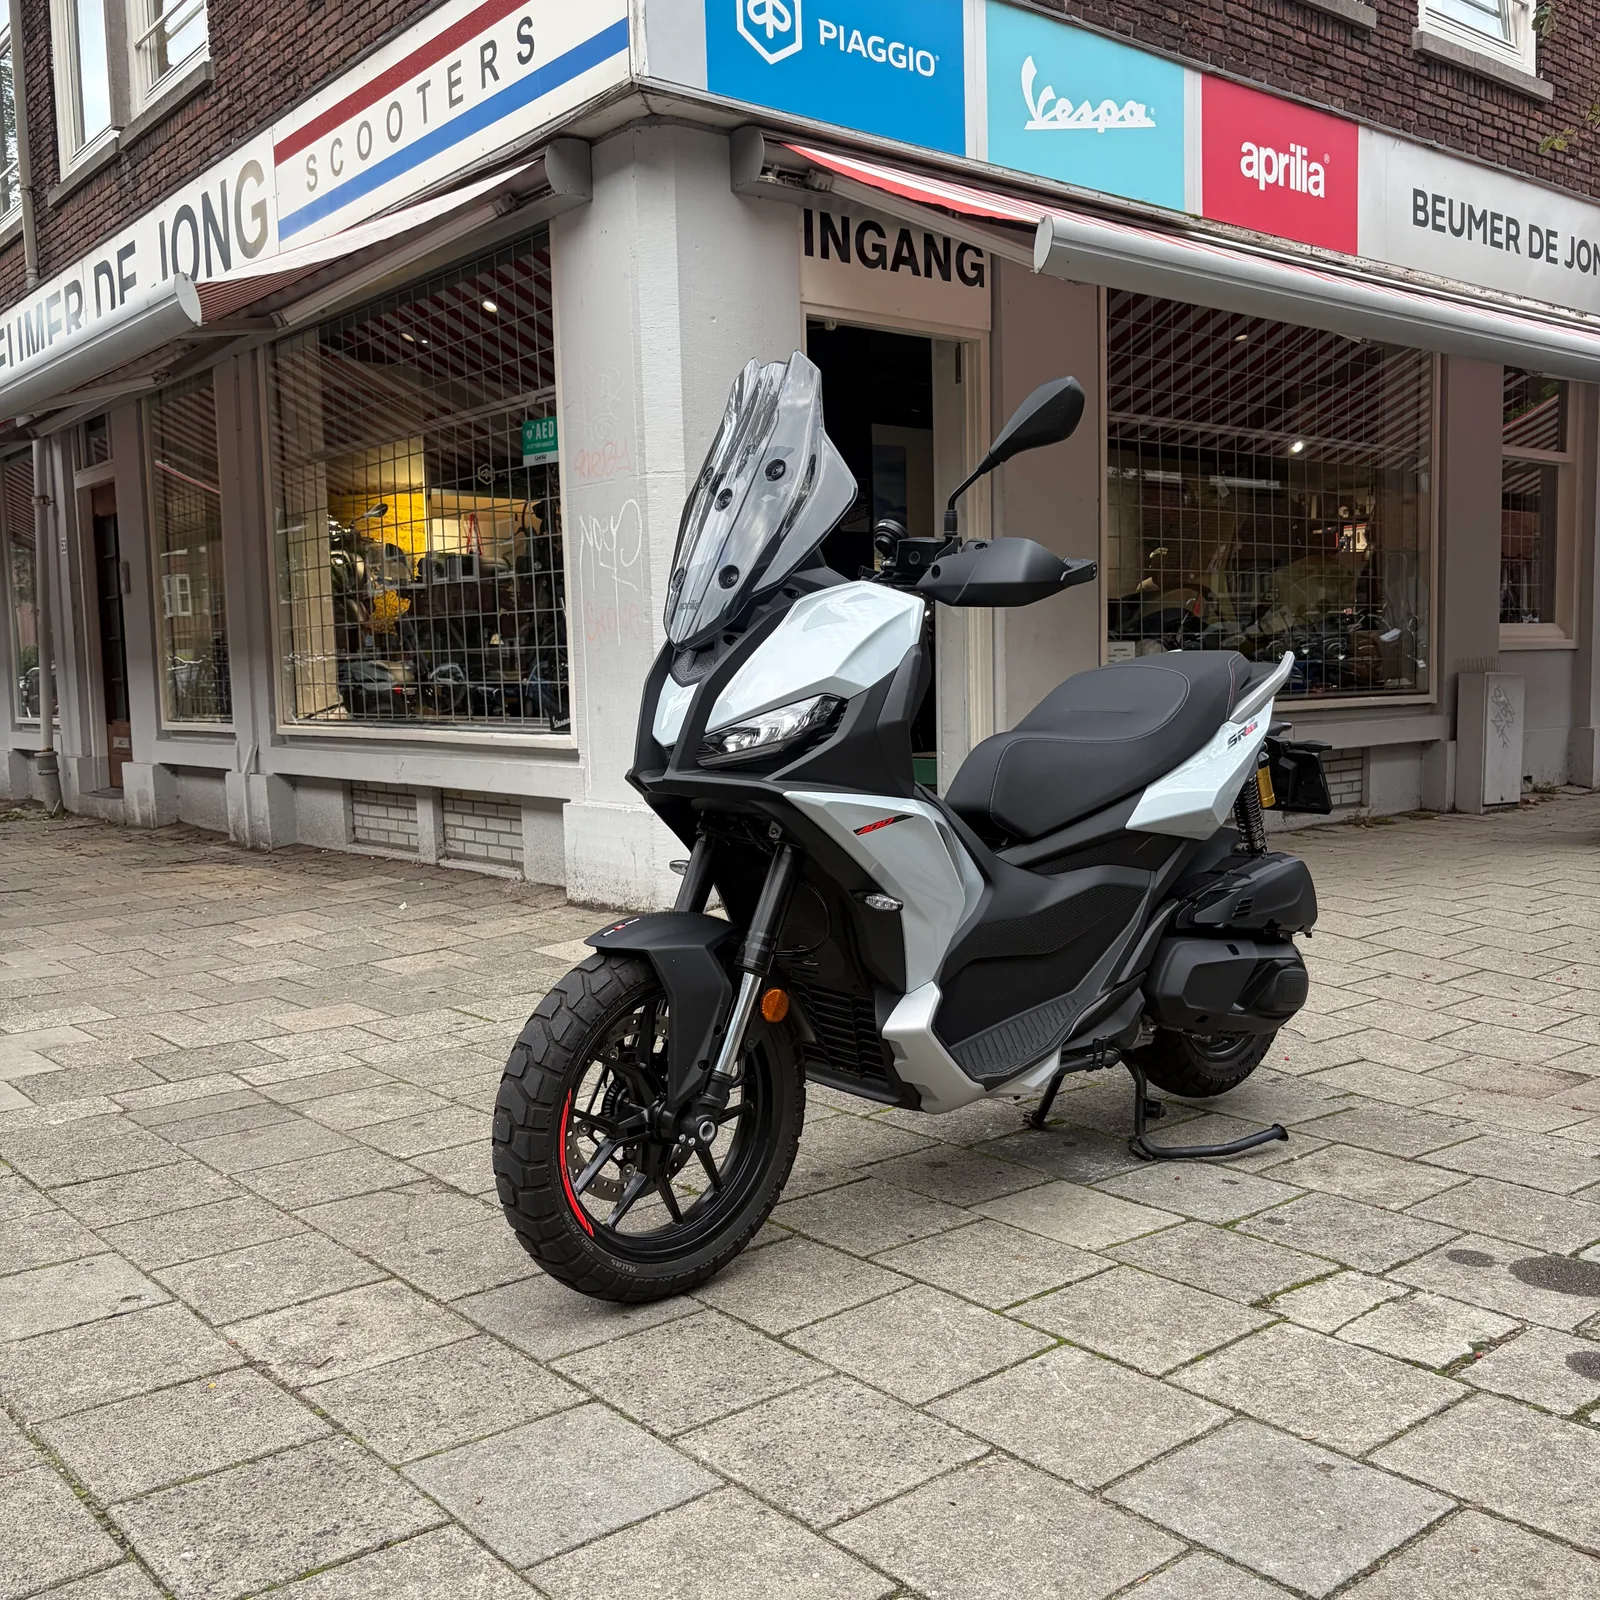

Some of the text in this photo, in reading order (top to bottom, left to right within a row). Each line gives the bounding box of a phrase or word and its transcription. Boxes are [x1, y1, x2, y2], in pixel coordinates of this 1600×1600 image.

[818, 18, 936, 78] PIAGGIO
[305, 16, 536, 193] SCOOTERS
[1021, 55, 1156, 133] Vespa
[1240, 141, 1325, 198] aprilia
[93, 240, 137, 319] DE
[150, 159, 268, 289] JONG
[803, 208, 986, 288] INGANG
[1412, 187, 1521, 254] BEUMER
[1528, 223, 1559, 265] DE
[536, 420, 554, 440] AED
